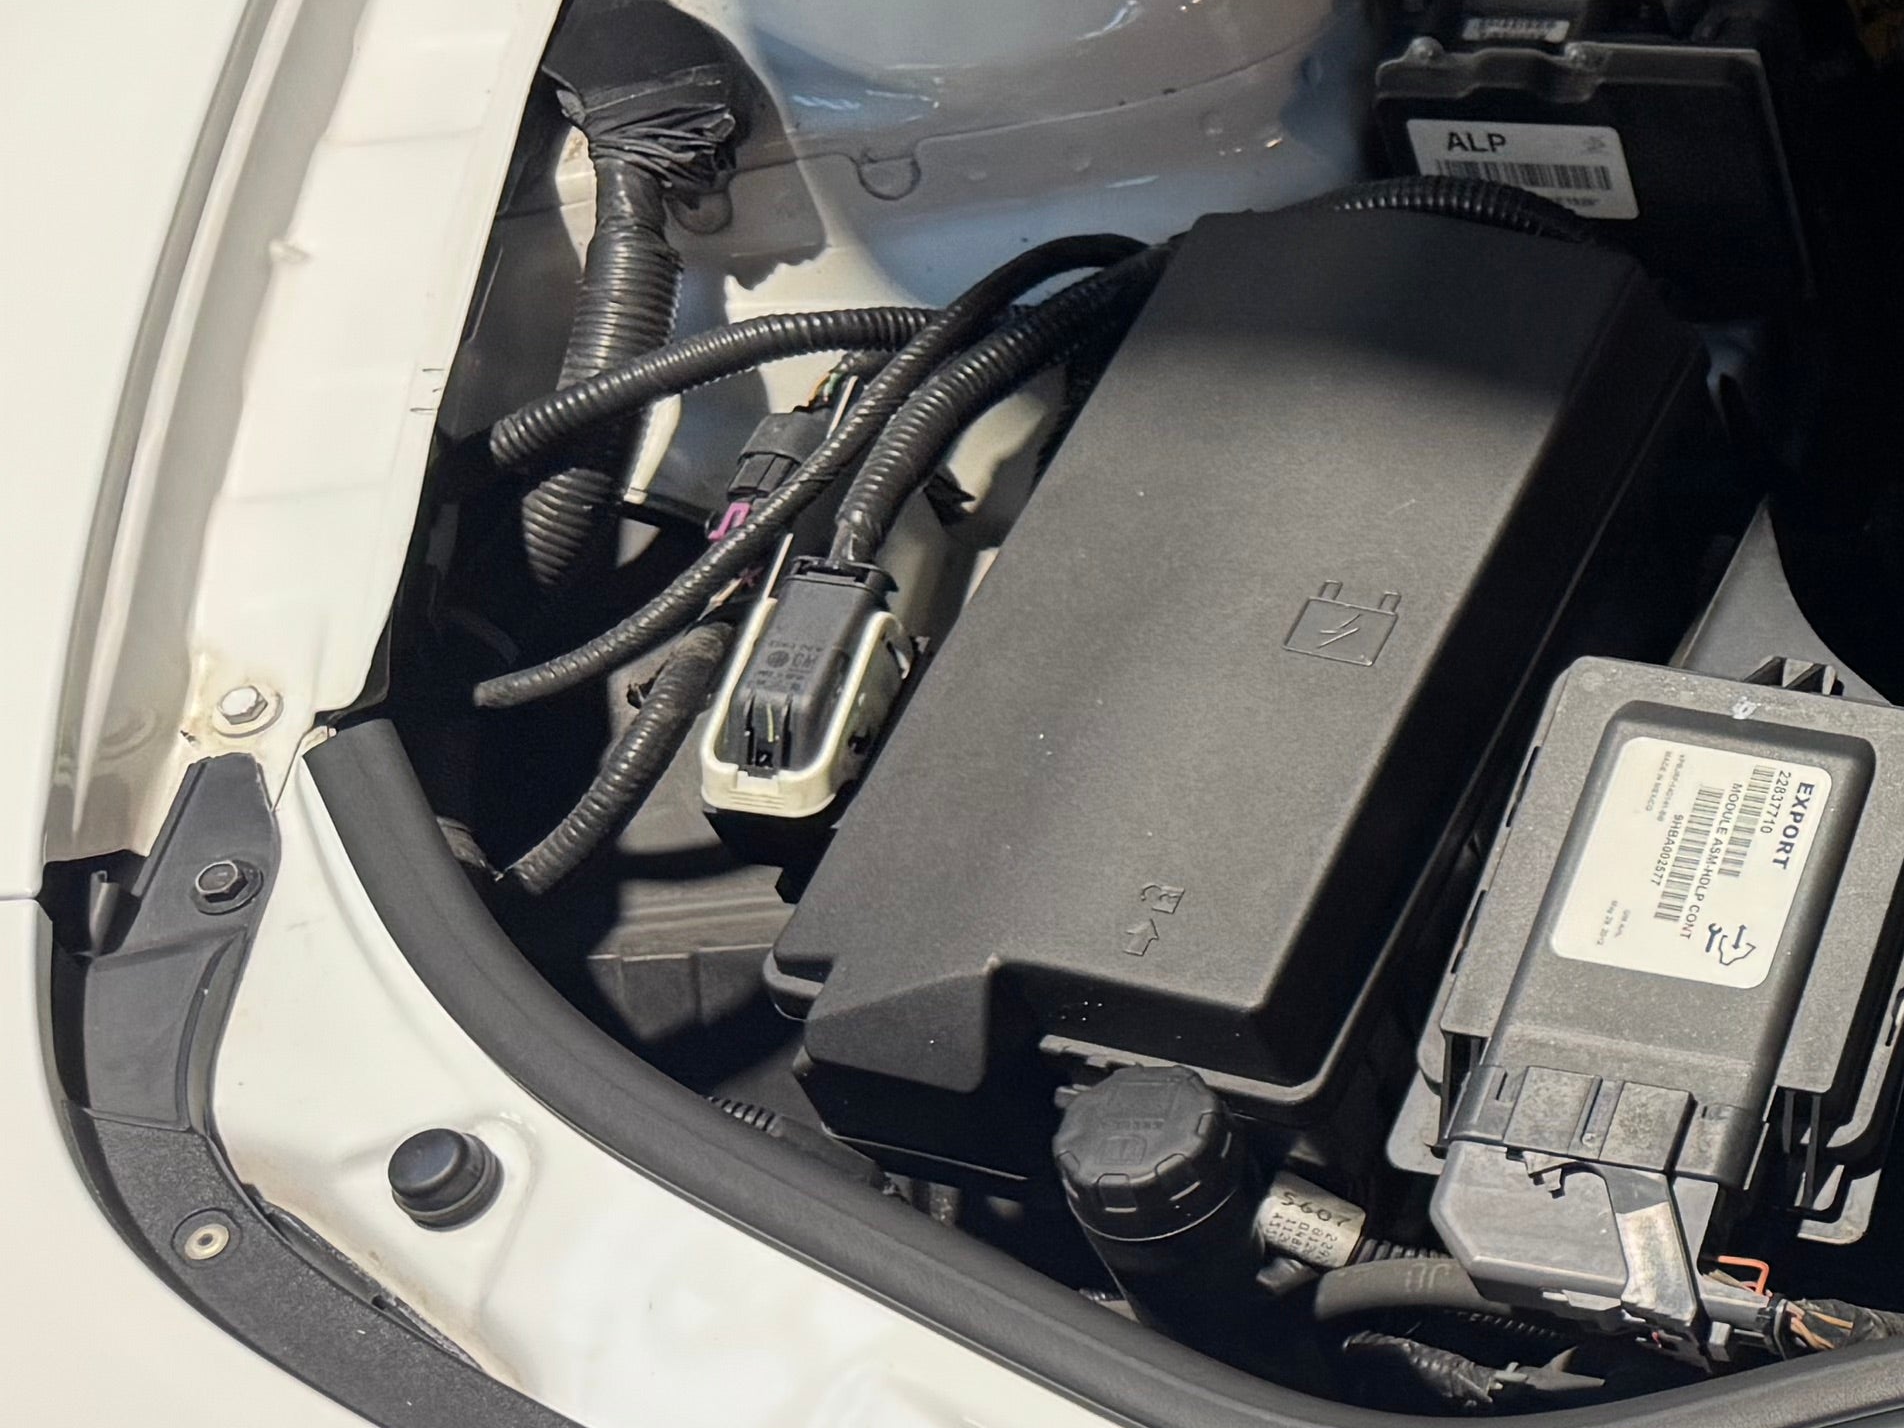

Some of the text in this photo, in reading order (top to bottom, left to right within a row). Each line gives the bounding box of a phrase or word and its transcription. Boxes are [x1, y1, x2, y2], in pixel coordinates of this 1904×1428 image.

[1447, 131, 1507, 153] ALP
[1714, 781, 1744, 835] MODULE
[1758, 769, 1792, 834] 22837710
[1770, 781, 1815, 870] EXPORT
[1677, 903, 1701, 940] CONT
